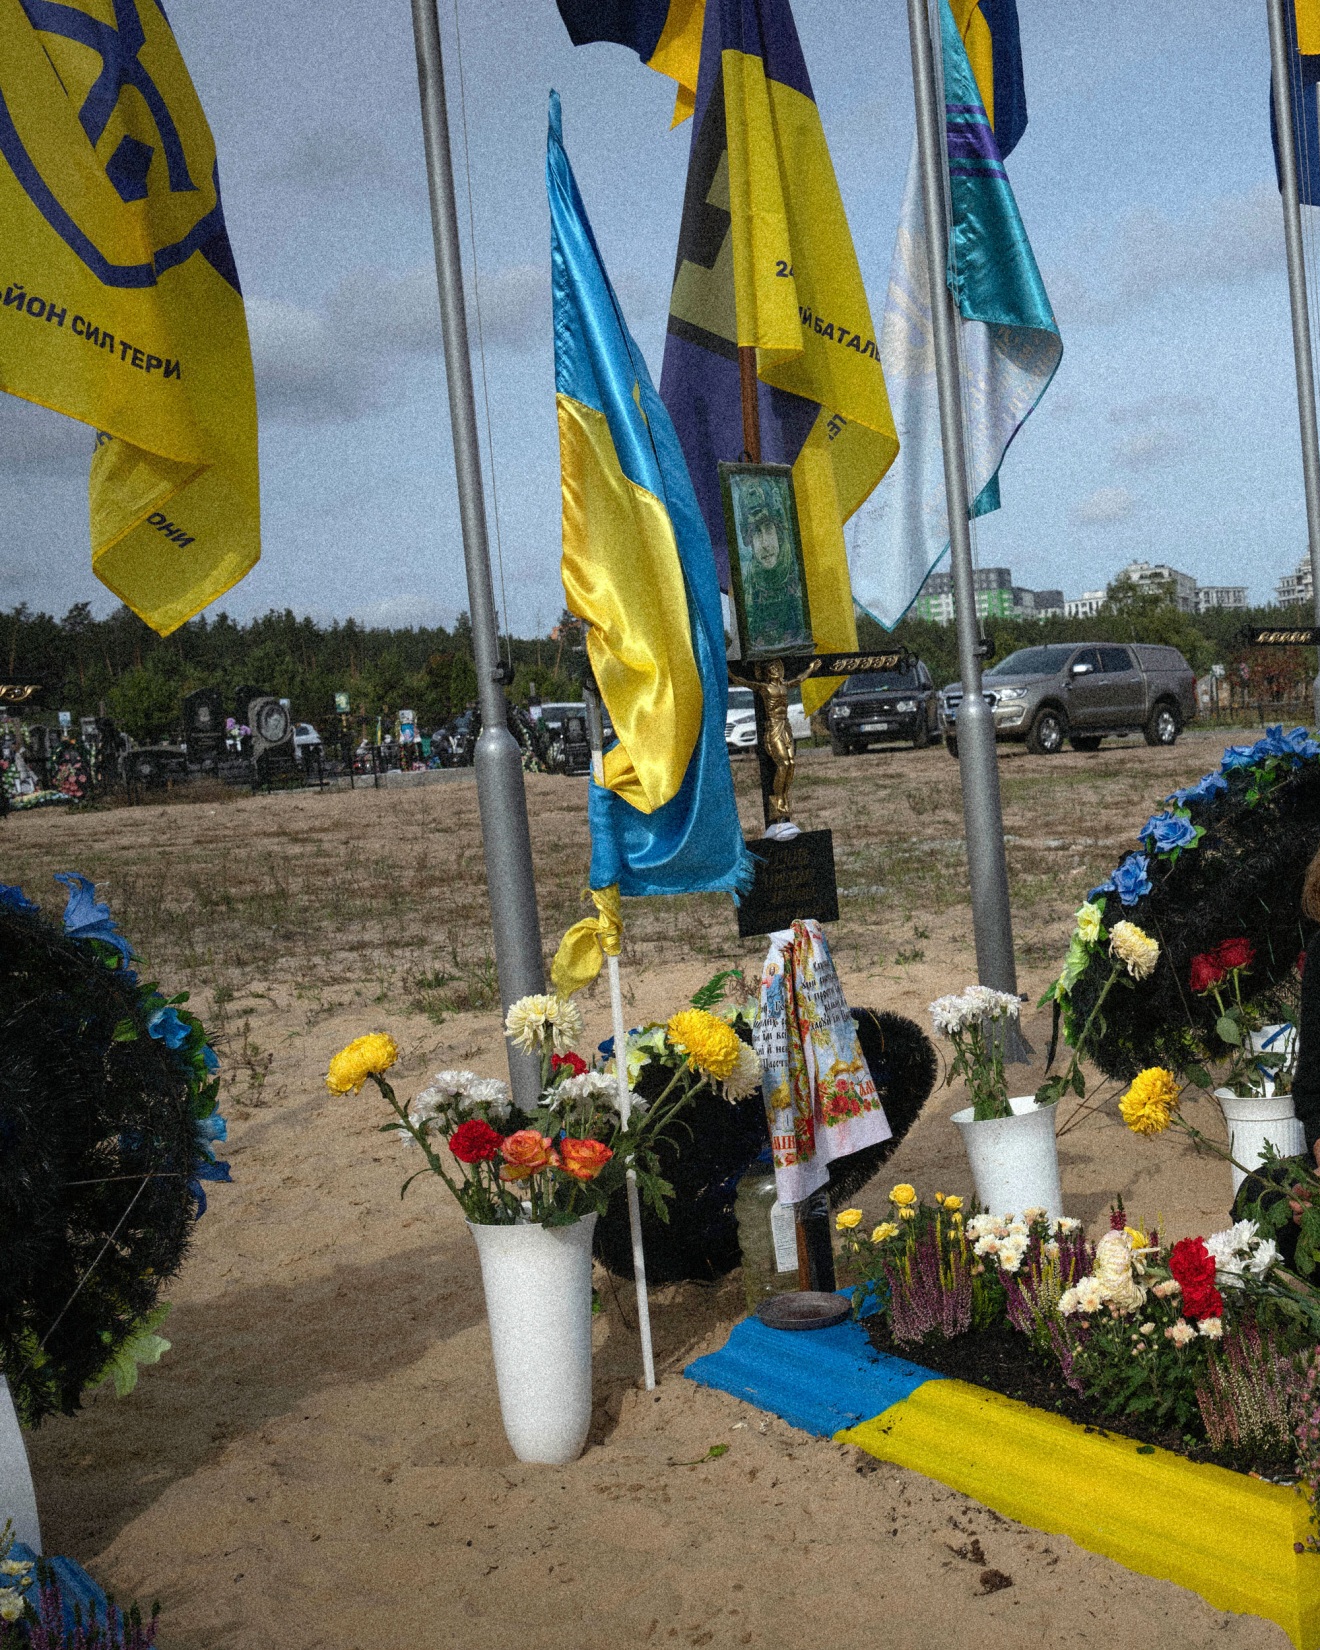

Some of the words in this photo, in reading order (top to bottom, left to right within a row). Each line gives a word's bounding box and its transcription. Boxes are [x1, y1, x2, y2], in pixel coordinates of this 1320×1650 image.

[0, 282, 67, 327] ЙОН
[71, 315, 115, 354] СИЛ
[119, 340, 181, 380] ТЕРИ
